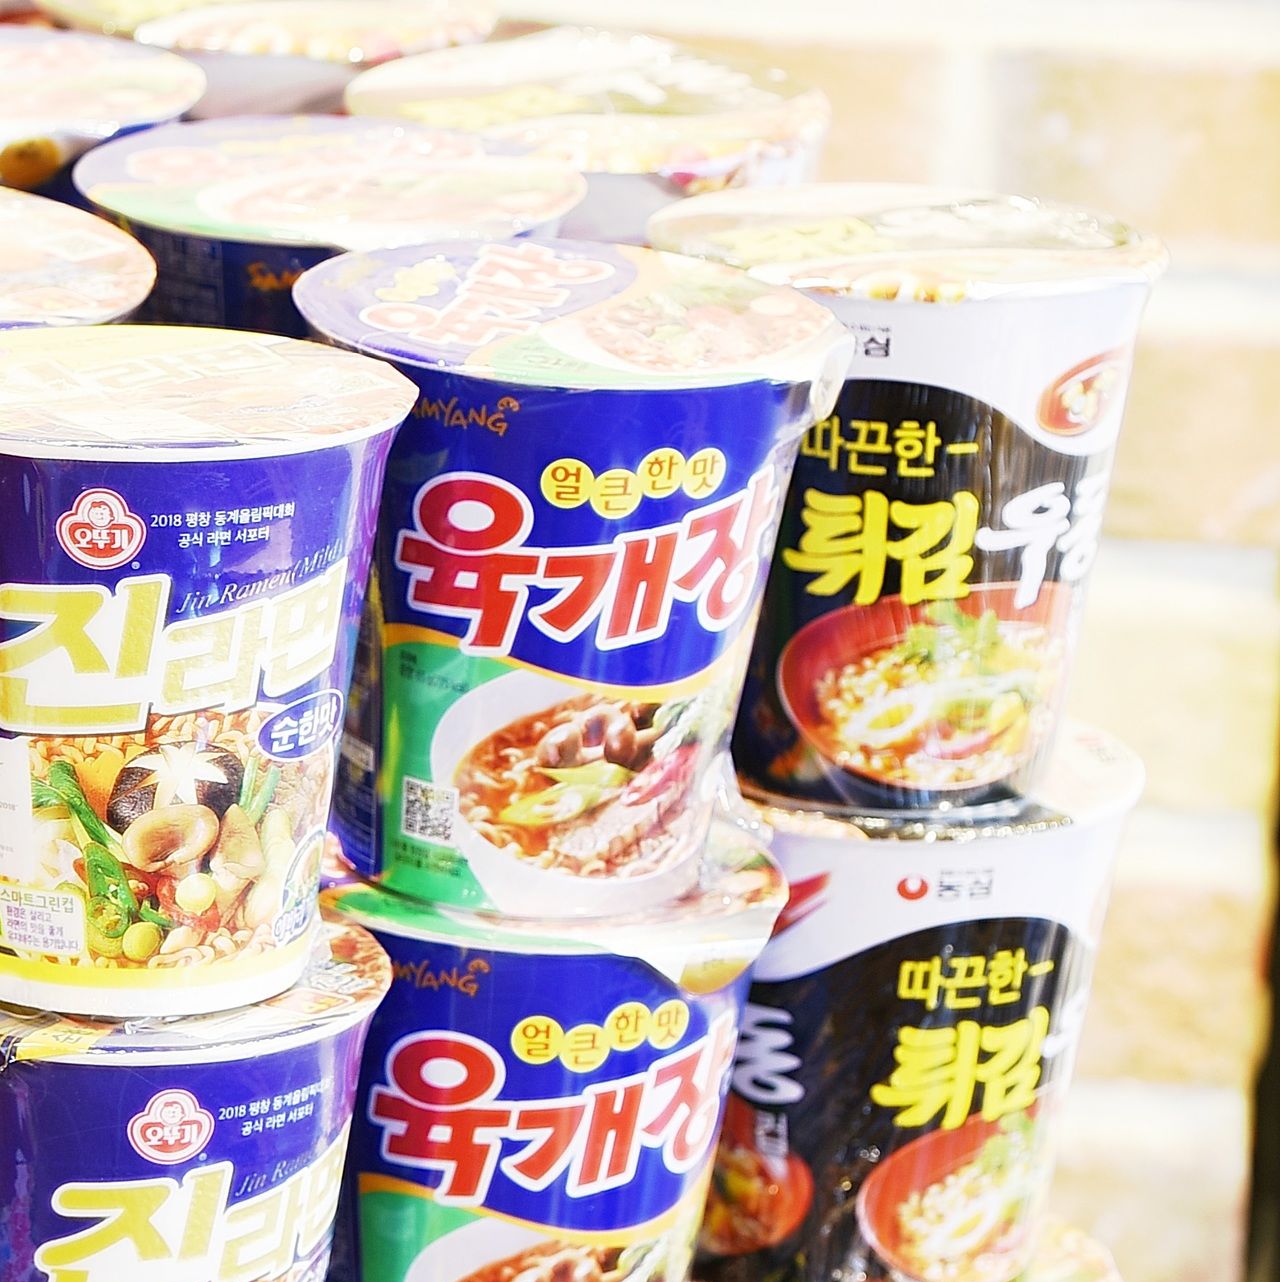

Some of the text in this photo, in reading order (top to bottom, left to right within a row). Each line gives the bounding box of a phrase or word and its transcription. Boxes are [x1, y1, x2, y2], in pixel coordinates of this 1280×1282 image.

[149, 513, 184, 530] 2018
[185, 509, 212, 530] 평창
[72, 527, 130, 553] 오뚜기
[178, 530, 203, 549] 공식
[233, 525, 271, 544] 서포터
[395, 464, 779, 655] 육개장
[270, 691, 339, 752] 순한맛
[871, 1005, 1051, 1130] 튀김
[218, 1107, 247, 1122] 2018
[369, 1012, 737, 1204] 육개장
[143, 1123, 201, 1147] 오뚜기
[241, 1120, 264, 1136] 공식
